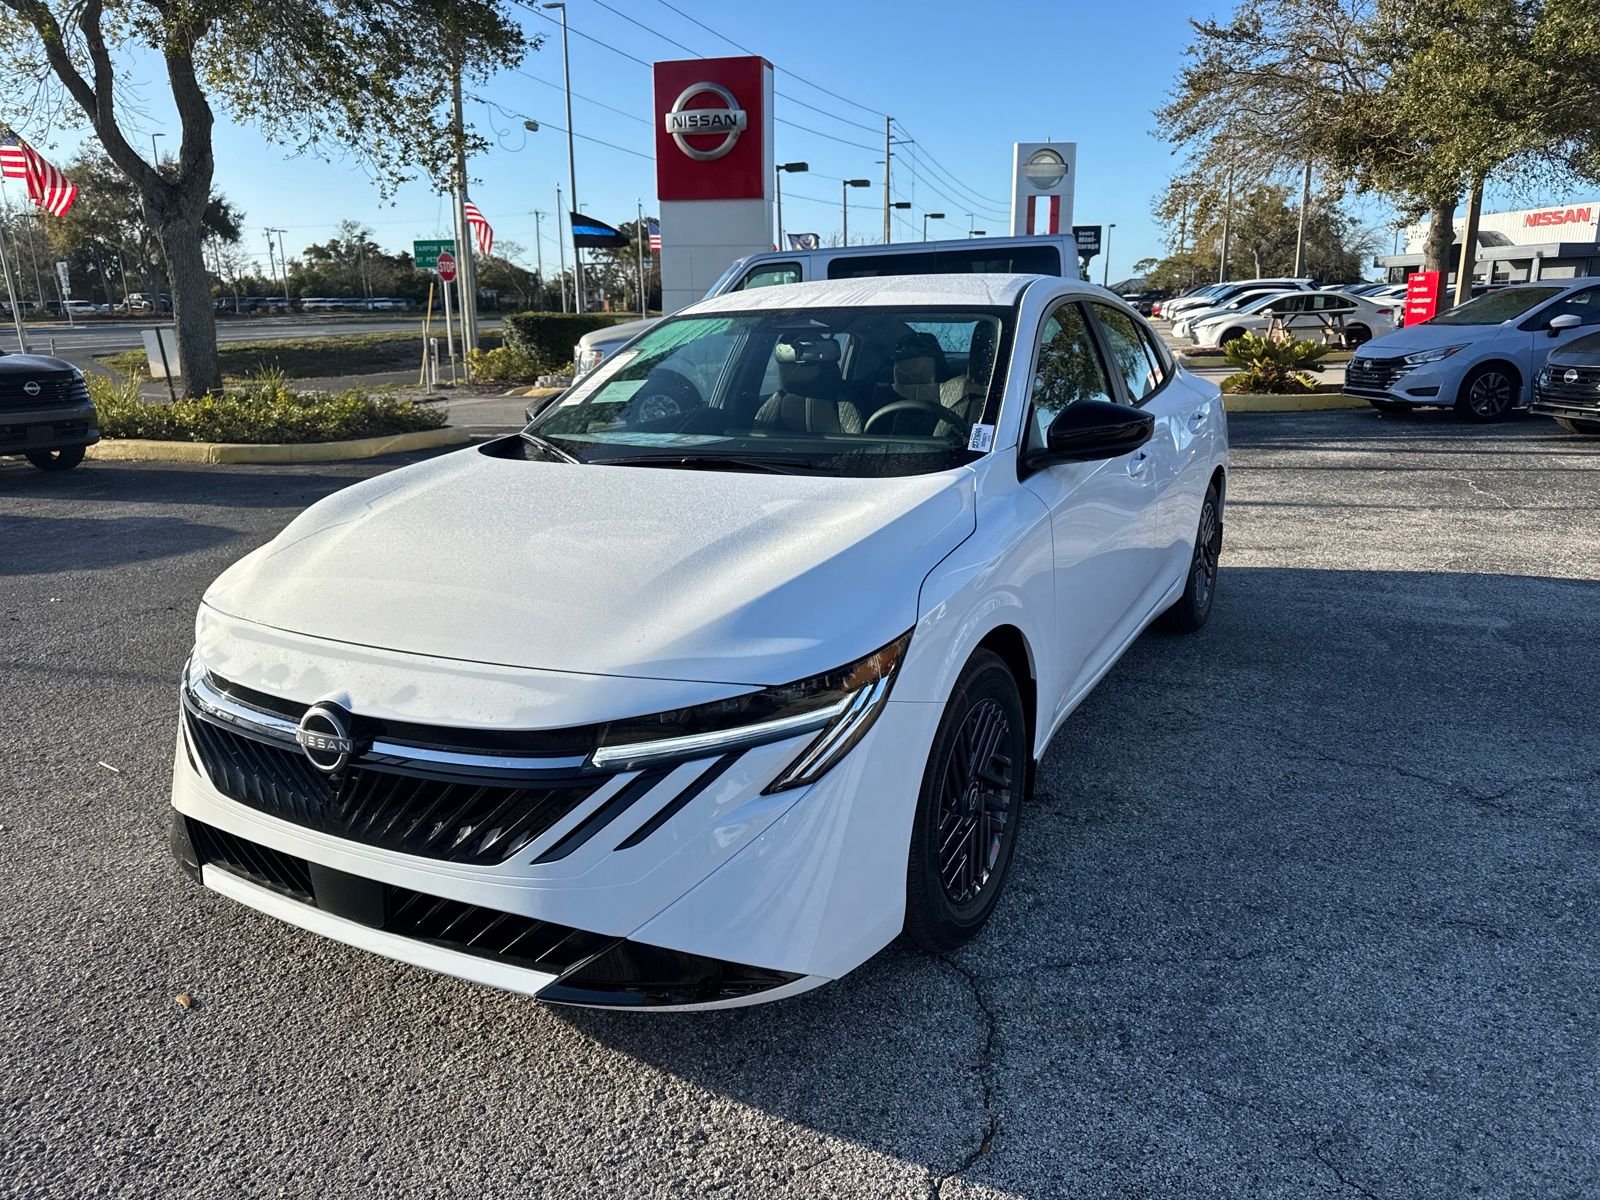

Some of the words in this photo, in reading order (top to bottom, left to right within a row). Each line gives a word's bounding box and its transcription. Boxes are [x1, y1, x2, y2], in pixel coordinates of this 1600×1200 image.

[672, 114, 737, 128] NISSAN
[1523, 207, 1592, 227] NISSAN
[439, 261, 455, 273] STOP
[296, 730, 351, 752] NISSAN
